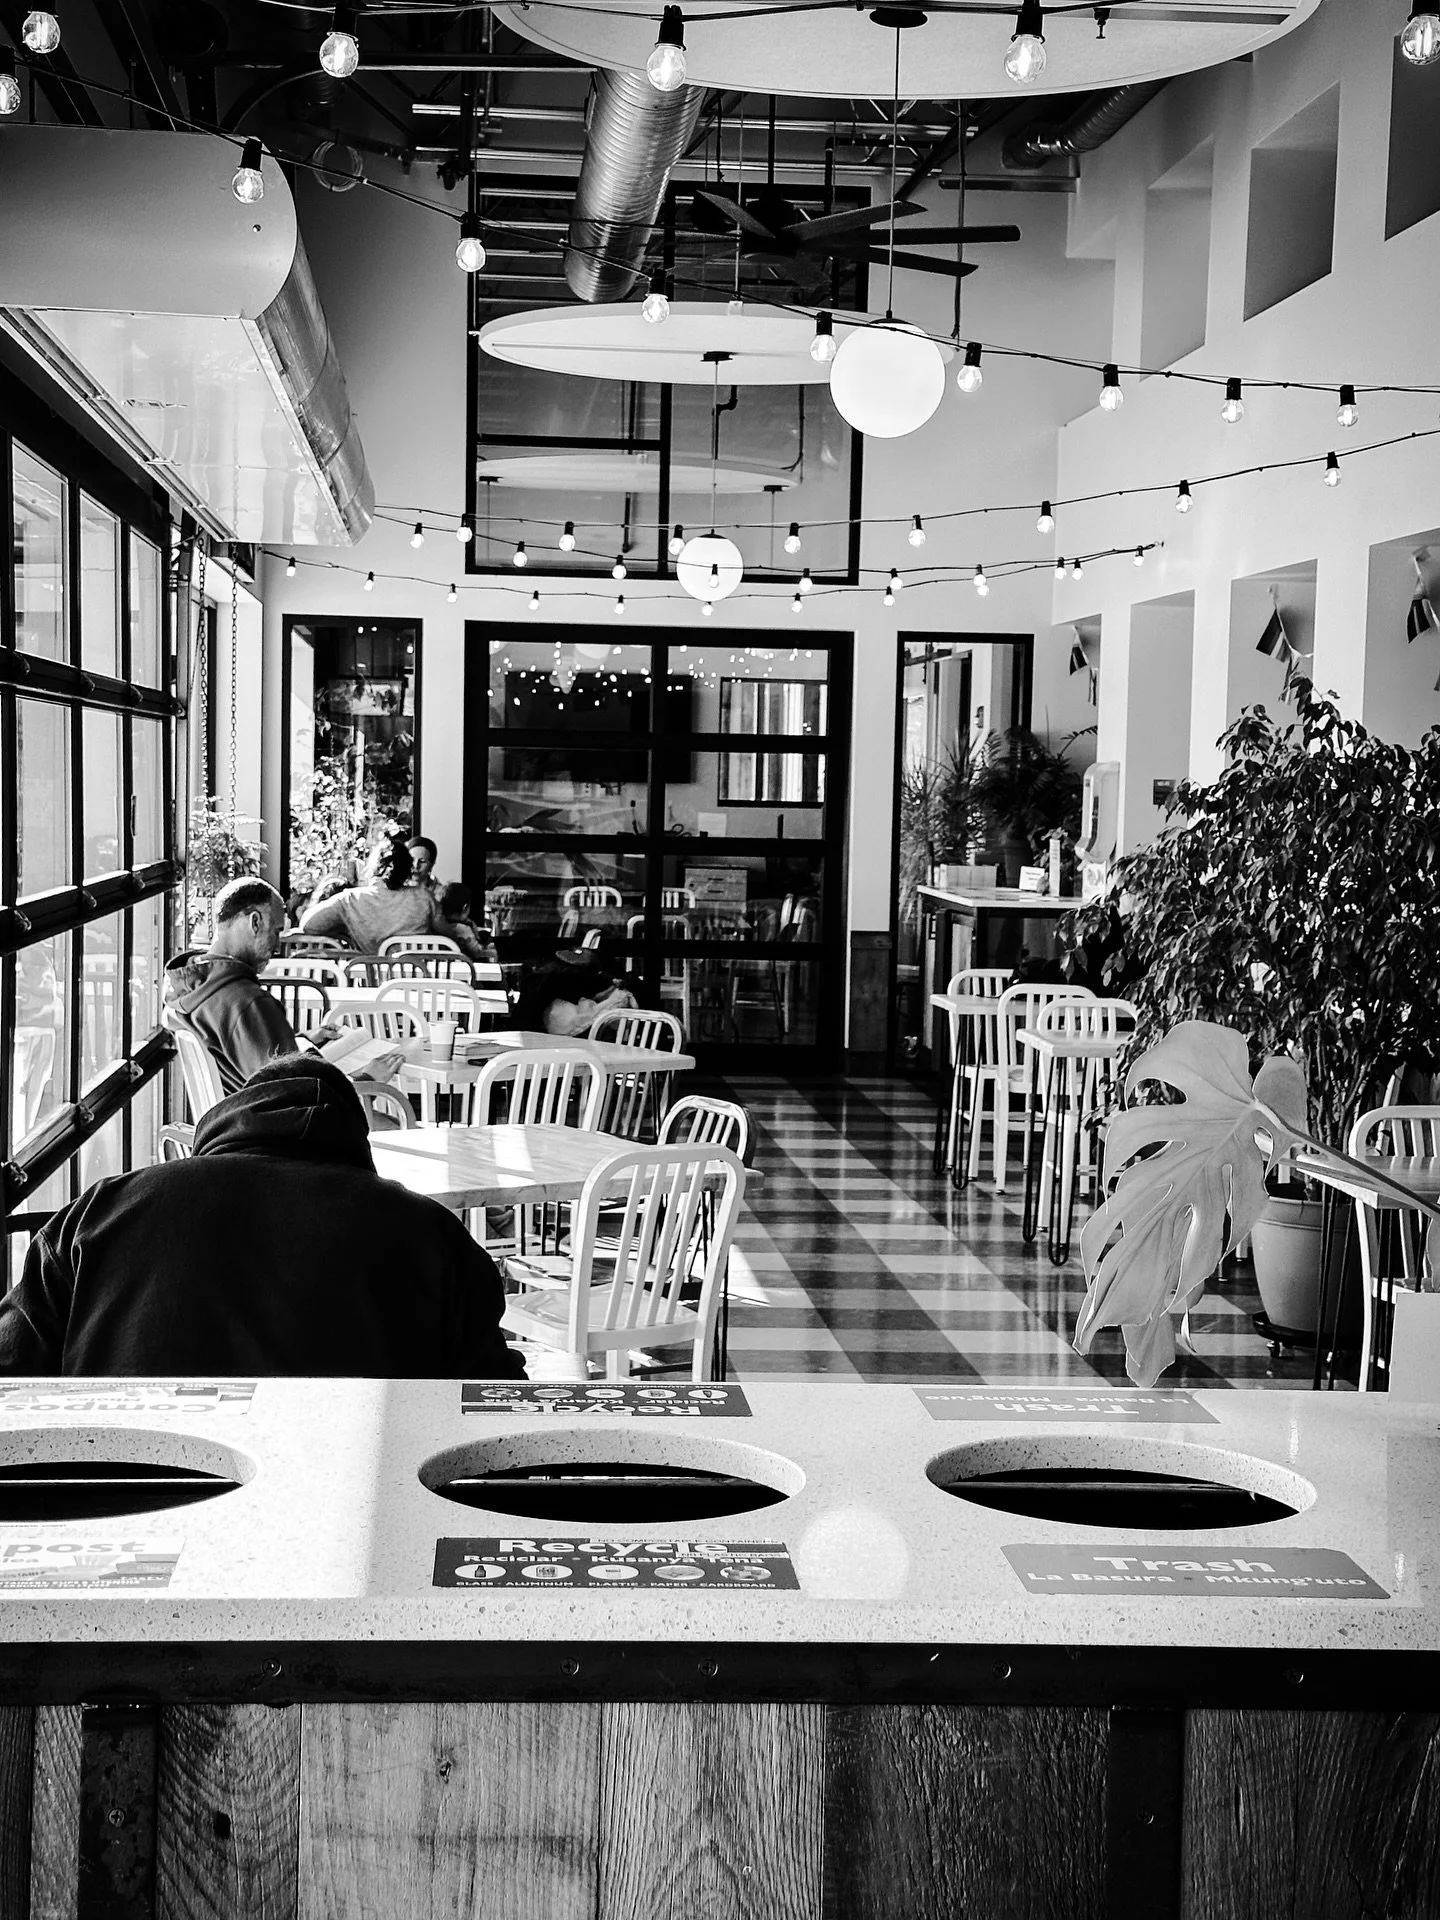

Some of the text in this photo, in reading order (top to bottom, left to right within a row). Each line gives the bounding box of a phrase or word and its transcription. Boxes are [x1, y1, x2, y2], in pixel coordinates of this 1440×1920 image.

[510, 1403, 700, 1415] Recycle
[994, 1403, 1139, 1414] Trash
[0, 1541, 146, 1557] post
[499, 1539, 728, 1557] Recycle
[590, 1556, 696, 1564] Kusanya
[1092, 1556, 1276, 1572] Trash
[1071, 1573, 1175, 1582] Basura
[1205, 1575, 1367, 1585] Mkung'uto
